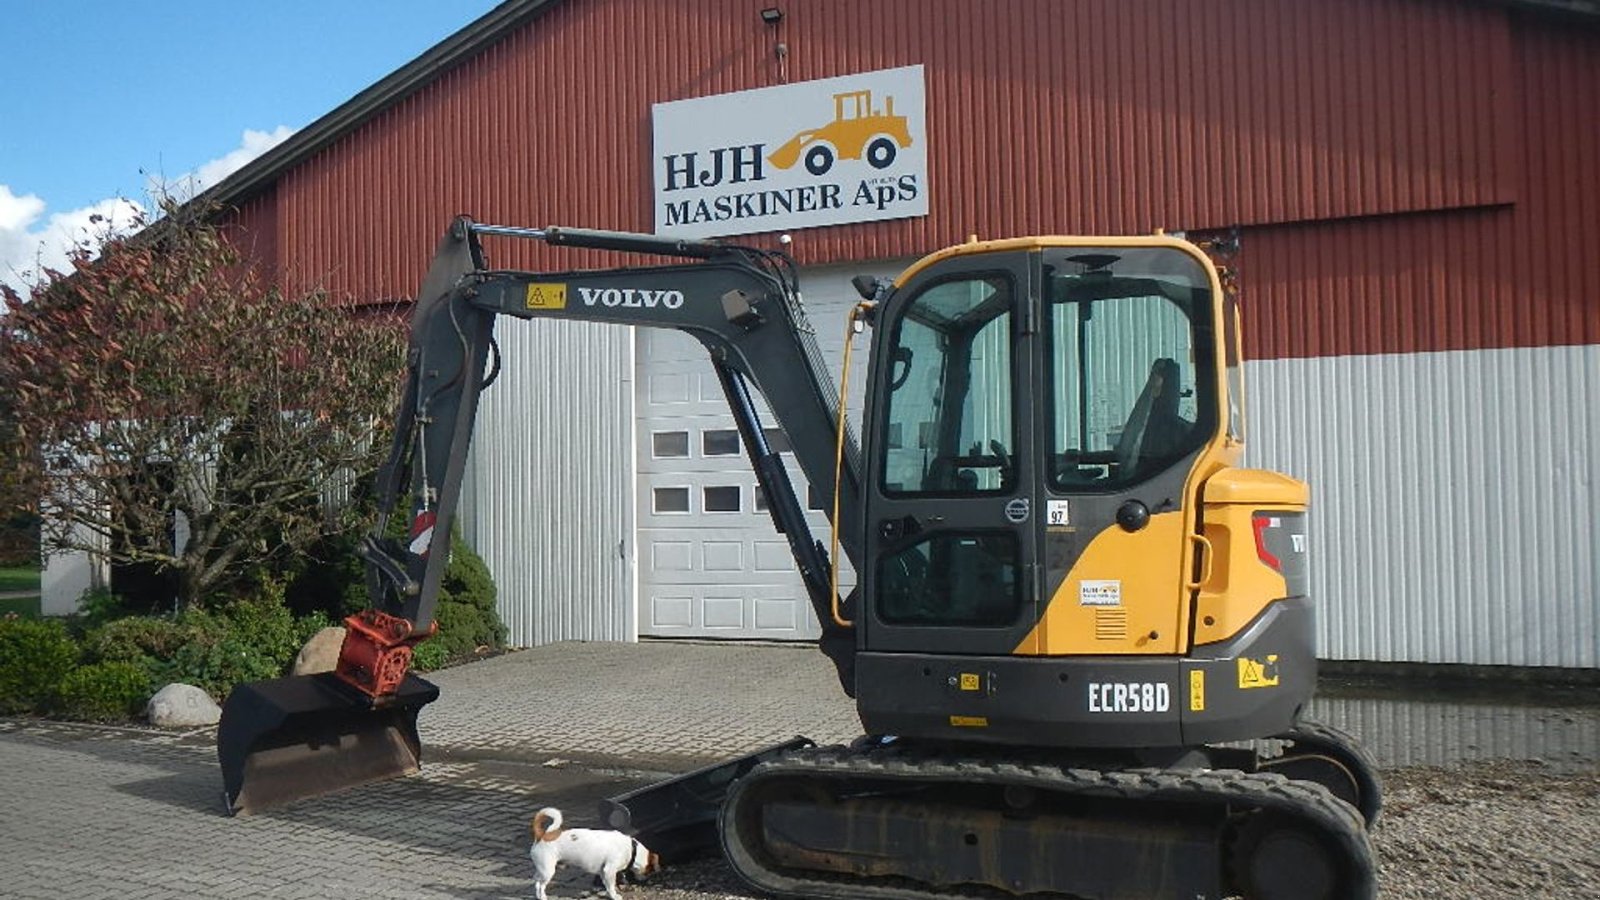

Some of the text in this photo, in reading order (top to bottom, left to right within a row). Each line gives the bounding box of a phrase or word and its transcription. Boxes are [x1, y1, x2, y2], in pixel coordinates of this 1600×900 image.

[663, 143, 767, 191] HJH
[664, 174, 917, 226] MASKINER ApS
[578, 287, 684, 309] VOLVO
[1051, 510, 1064, 523] 97
[1089, 683, 1169, 712] ECR58D
